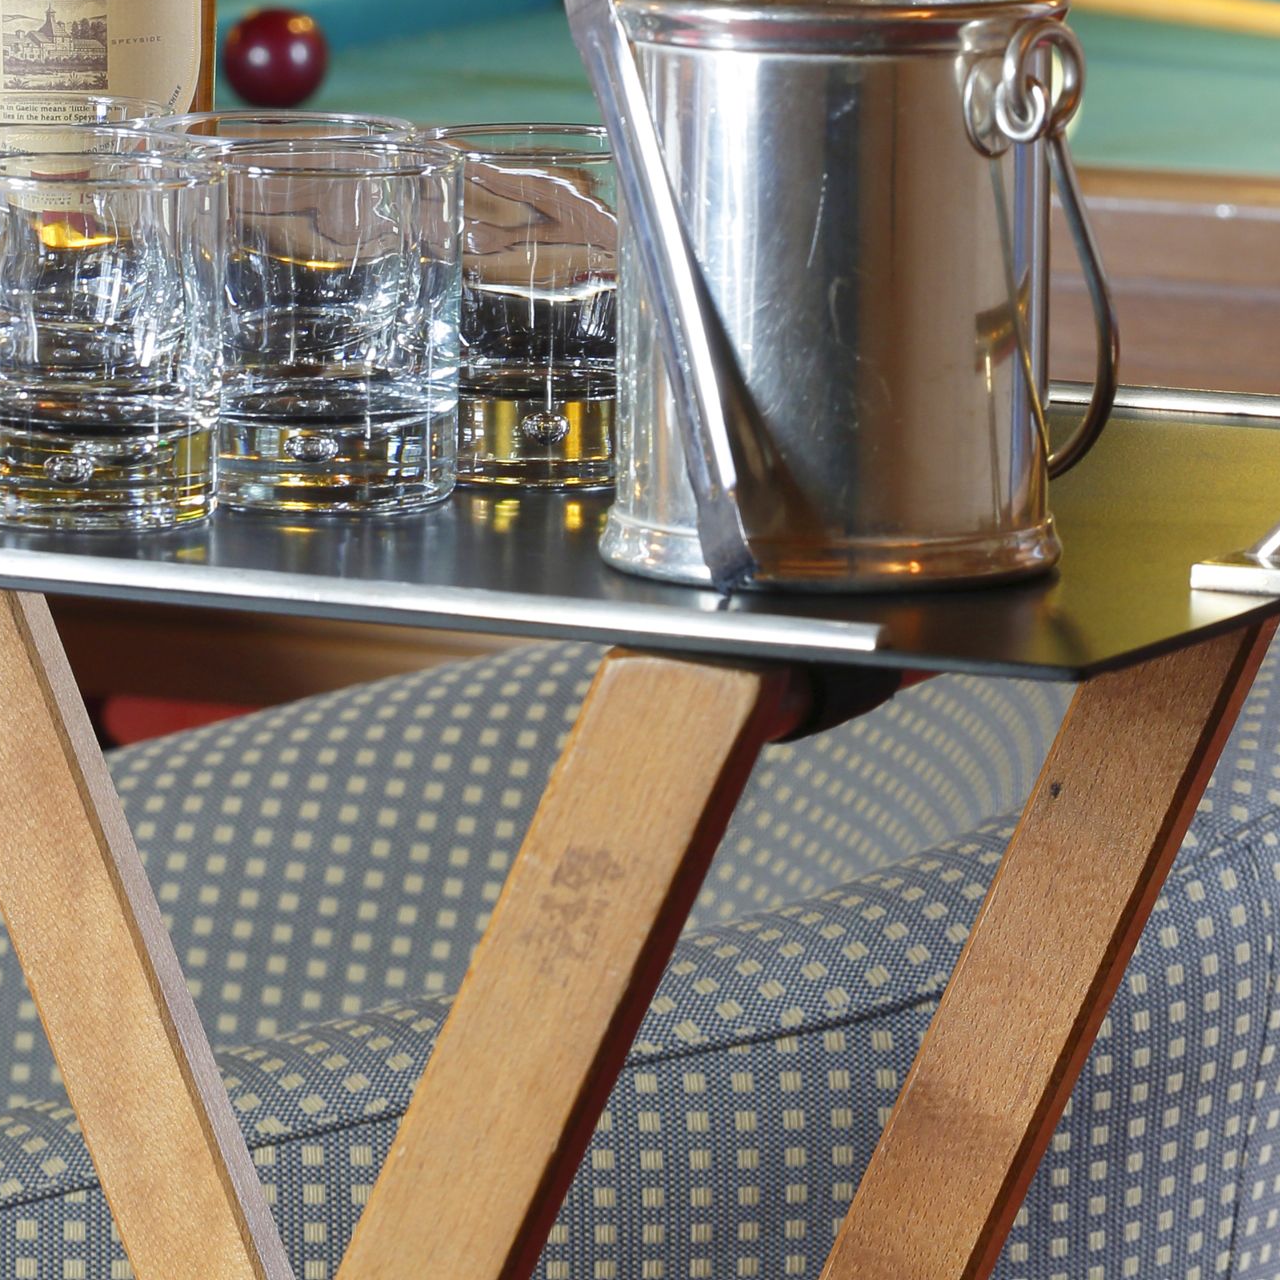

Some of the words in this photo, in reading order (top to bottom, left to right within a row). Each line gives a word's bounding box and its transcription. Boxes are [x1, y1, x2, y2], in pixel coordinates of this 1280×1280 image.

[111, 35, 162, 45] SPEYSIDE
[16, 104, 39, 112] Gaelic
[40, 105, 67, 113] means
[2, 111, 15, 120] lies
[16, 112, 25, 120] in
[26, 112, 39, 121] the
[40, 113, 62, 121] heart
[63, 113, 73, 121] of
